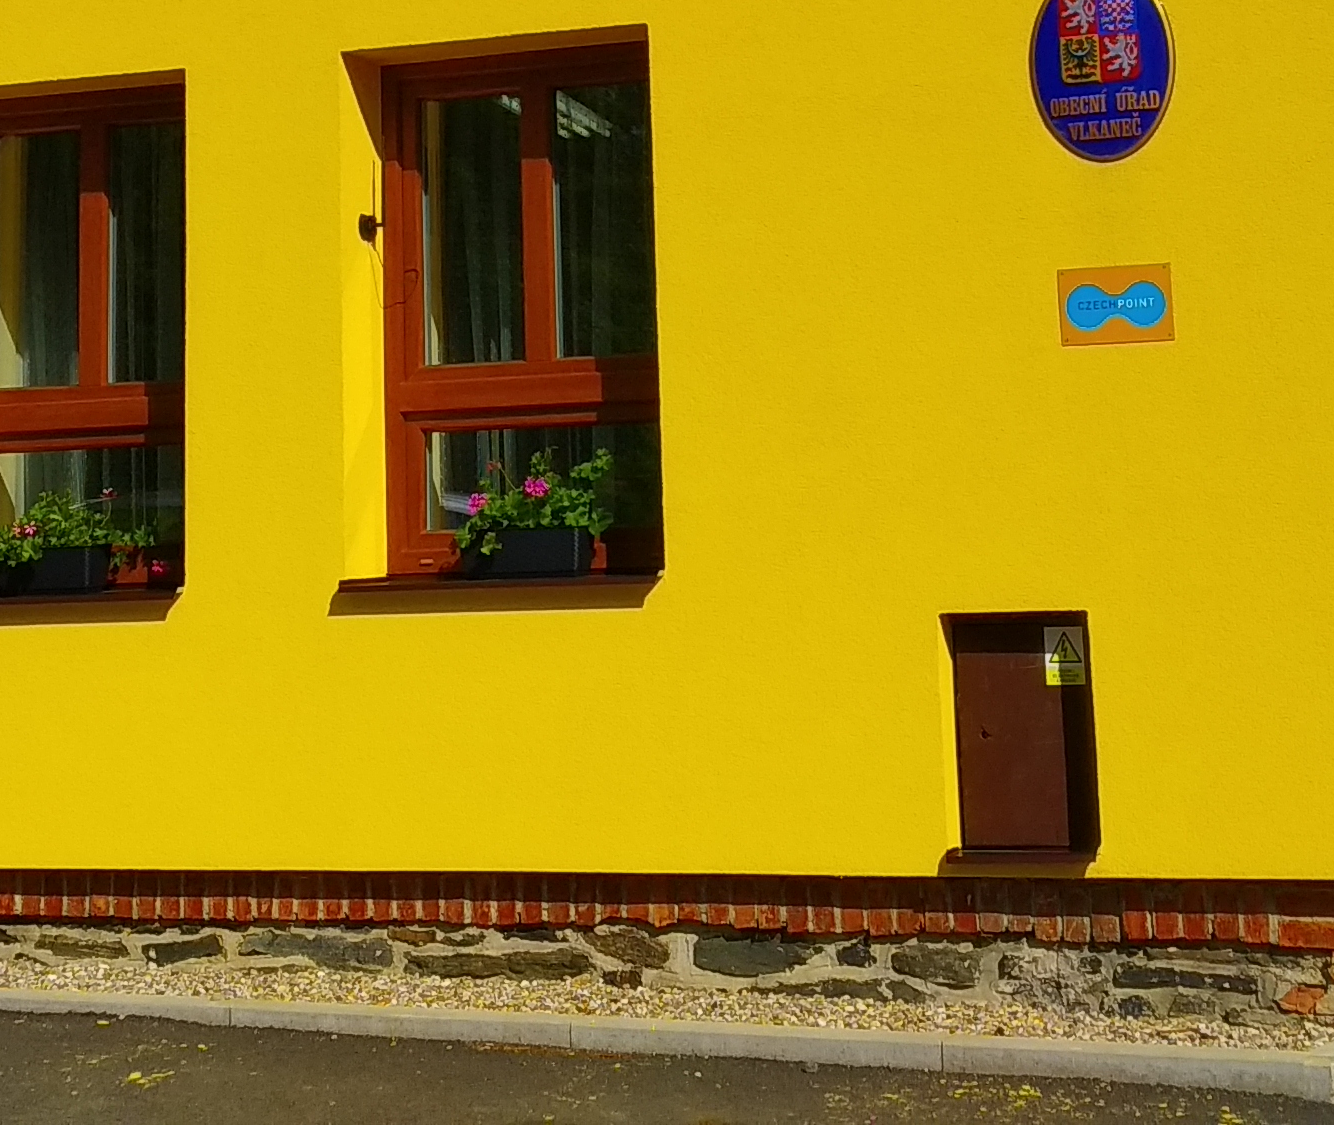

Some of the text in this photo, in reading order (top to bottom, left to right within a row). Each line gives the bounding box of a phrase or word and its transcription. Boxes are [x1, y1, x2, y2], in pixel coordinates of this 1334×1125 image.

[1050, 86, 1160, 117] OBECNÍ ÚŘAD
[1068, 112, 1142, 141] VLKANEČ
